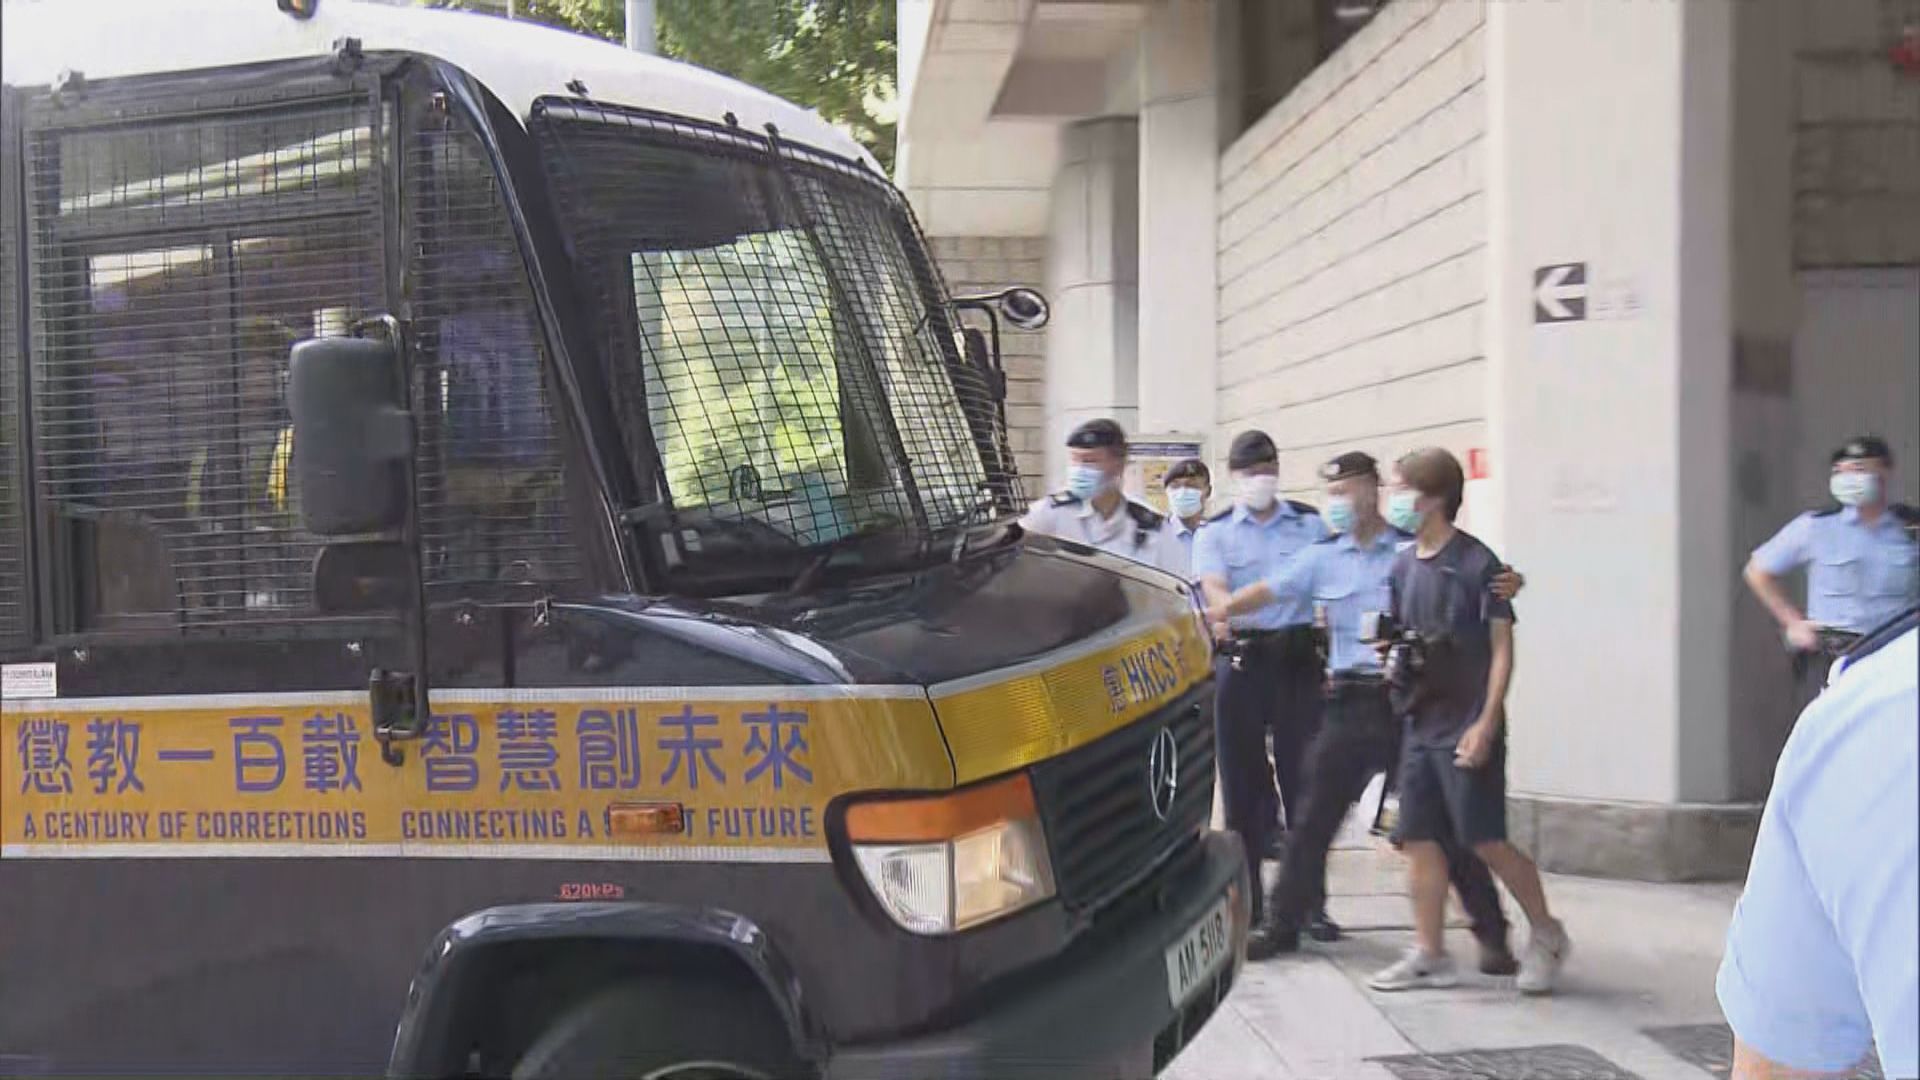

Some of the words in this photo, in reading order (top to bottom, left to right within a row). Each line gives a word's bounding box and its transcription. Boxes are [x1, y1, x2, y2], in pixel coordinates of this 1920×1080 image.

[1120, 639, 1178, 703] HKCS
[17, 713, 363, 795] 懲教一百載
[420, 704, 813, 792] 智慧創未來
[23, 812, 36, 839] A
[45, 811, 149, 839] CENTURY
[159, 811, 187, 839] OF
[196, 811, 367, 840] CORRECTIONS
[401, 810, 566, 839] CONNECTING
[577, 809, 594, 837] A
[708, 807, 817, 837] FUTURE
